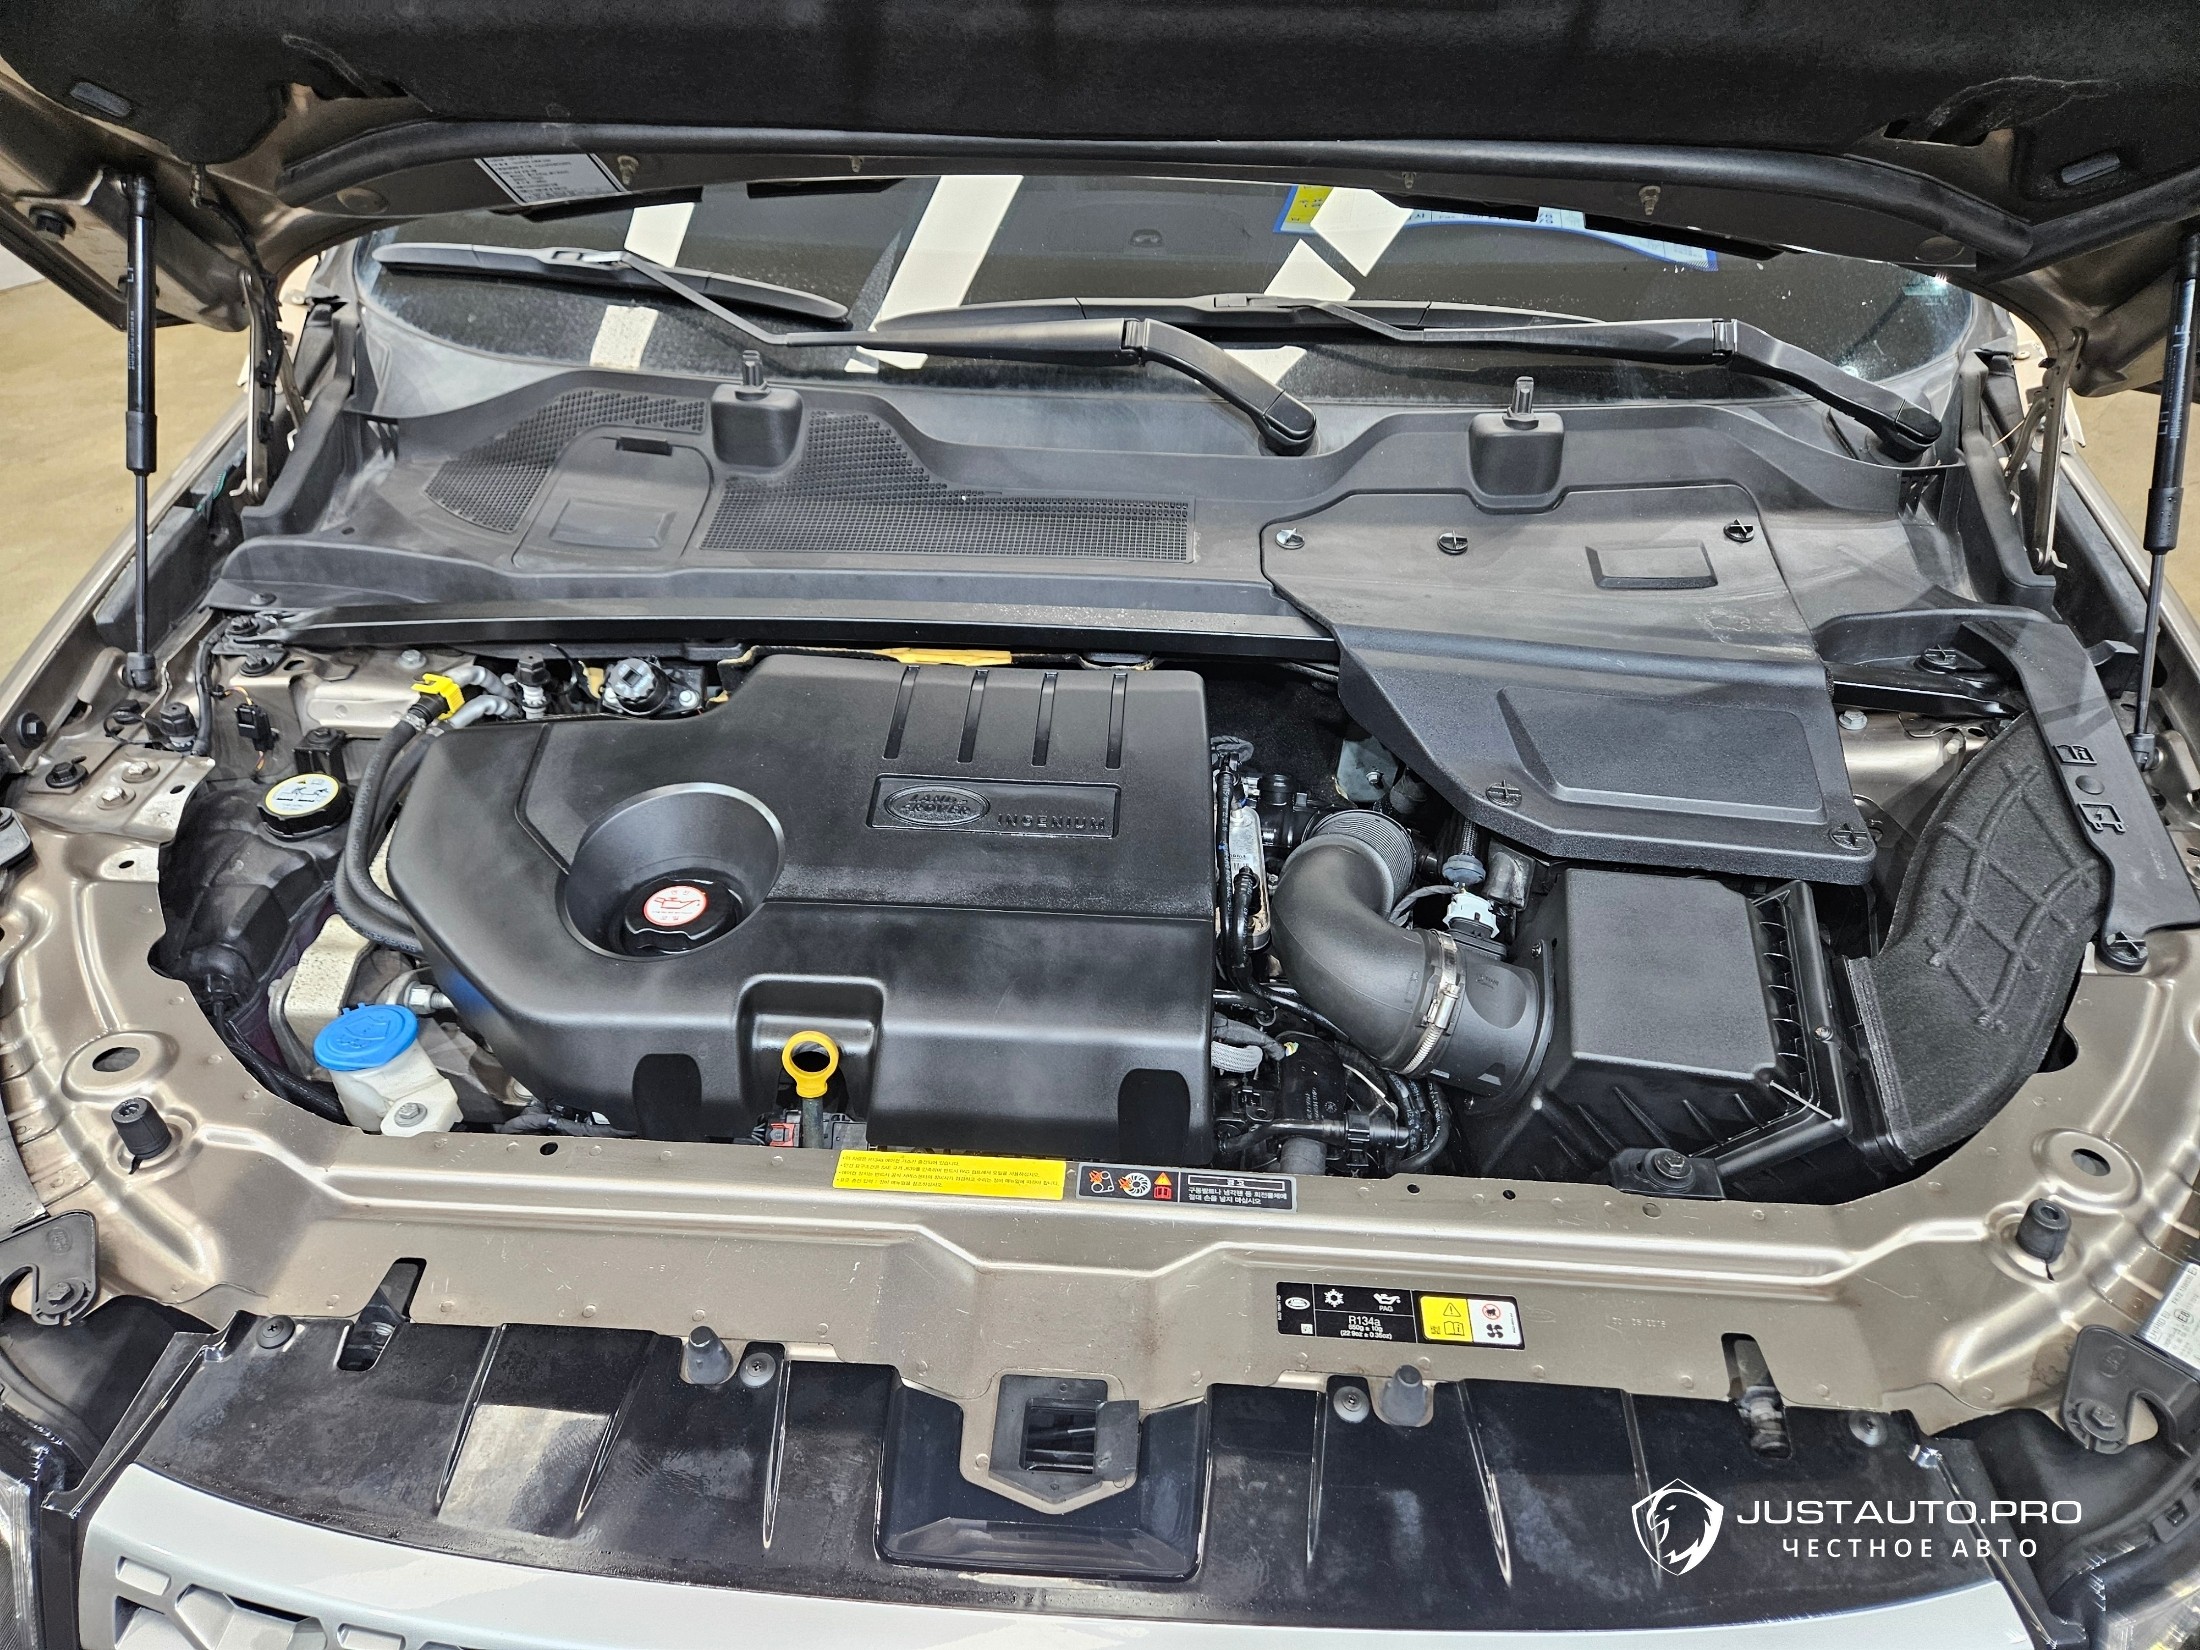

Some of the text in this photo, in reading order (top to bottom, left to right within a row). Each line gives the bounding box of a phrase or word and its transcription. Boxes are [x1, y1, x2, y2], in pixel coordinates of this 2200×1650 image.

[908, 793, 957, 804] LAND
[910, 803, 972, 815] ROVER
[997, 812, 1106, 830] INGENIUM
[1348, 1315, 1381, 1326] R134a
